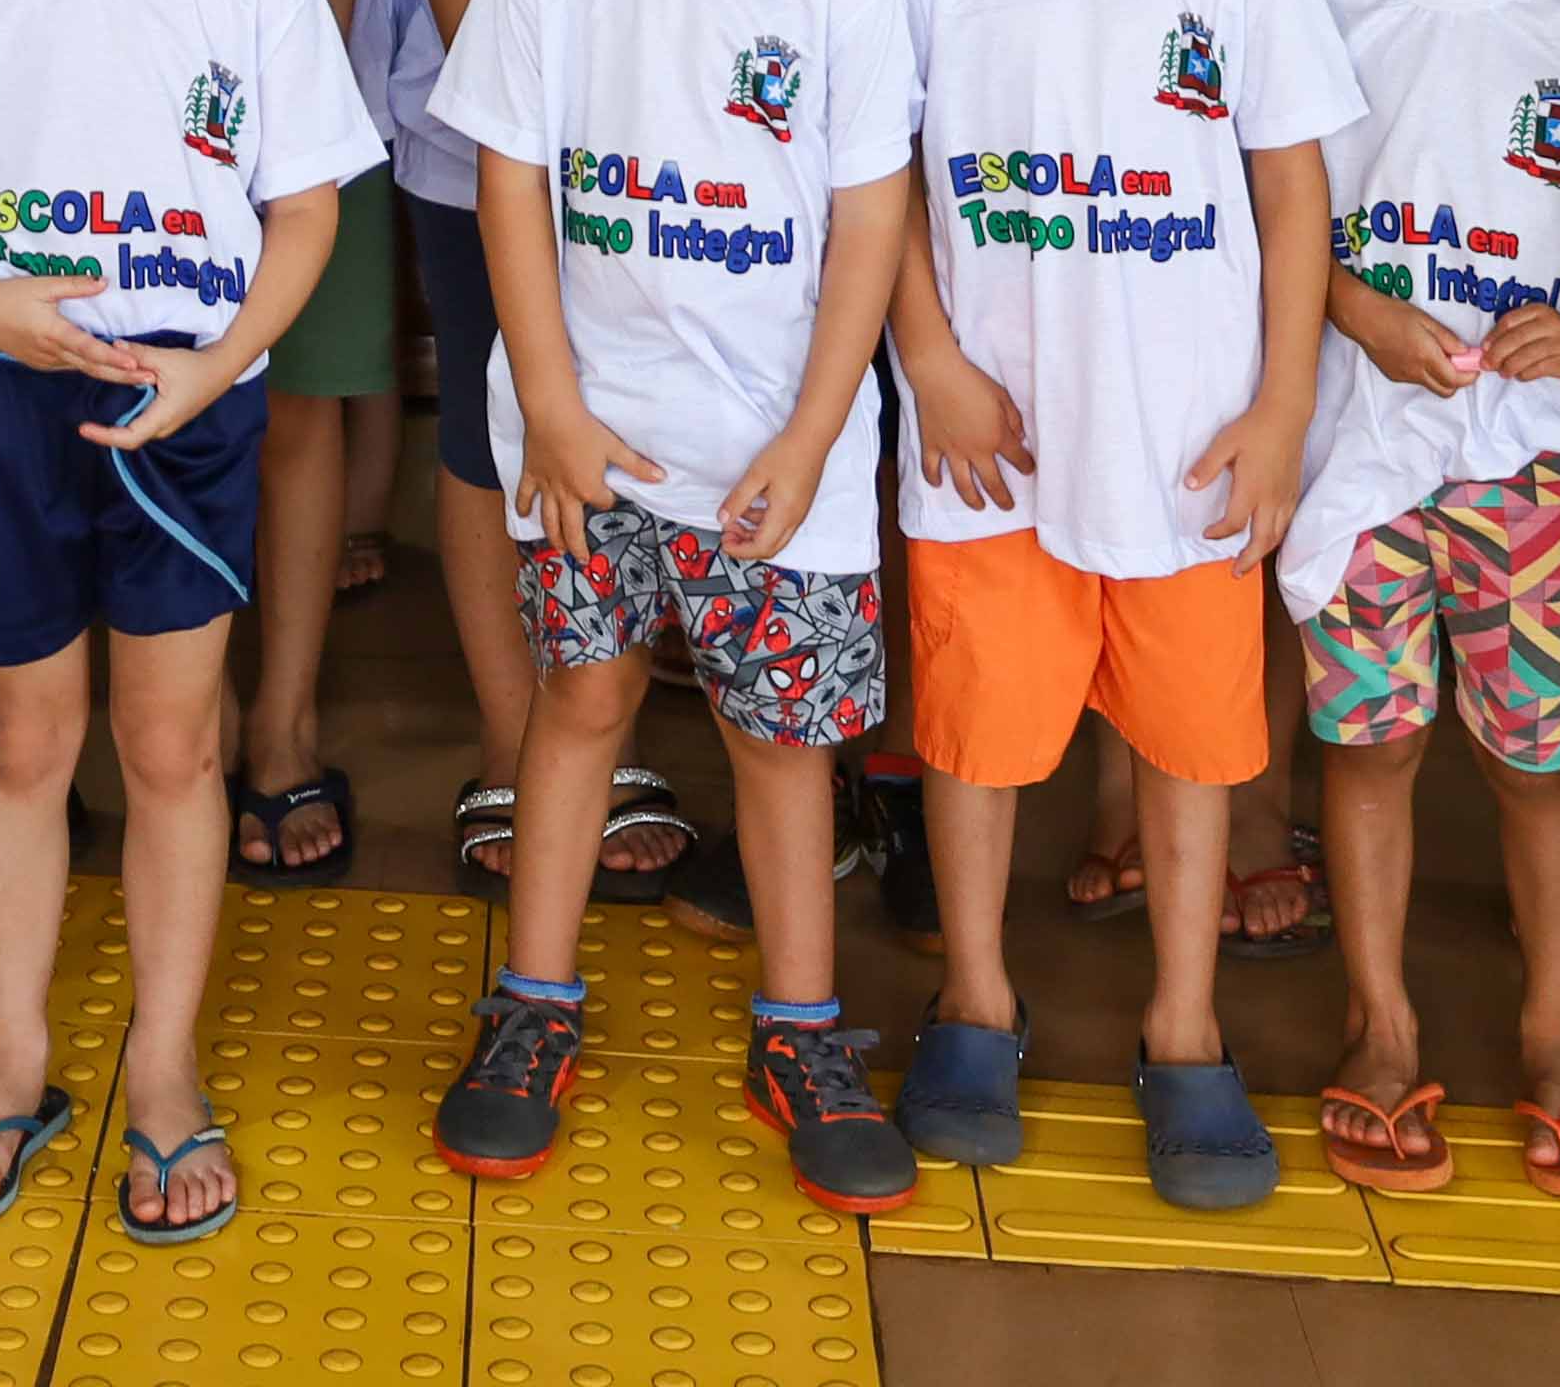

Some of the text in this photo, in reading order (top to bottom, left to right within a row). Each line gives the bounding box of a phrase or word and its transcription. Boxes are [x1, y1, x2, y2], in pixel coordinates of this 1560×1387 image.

[694, 178, 747, 210] em
[948, 149, 1172, 198] ESCOLA em
[649, 208, 794, 275] Integral
[1088, 203, 1216, 263] Integral
[1466, 225, 1519, 259] em
